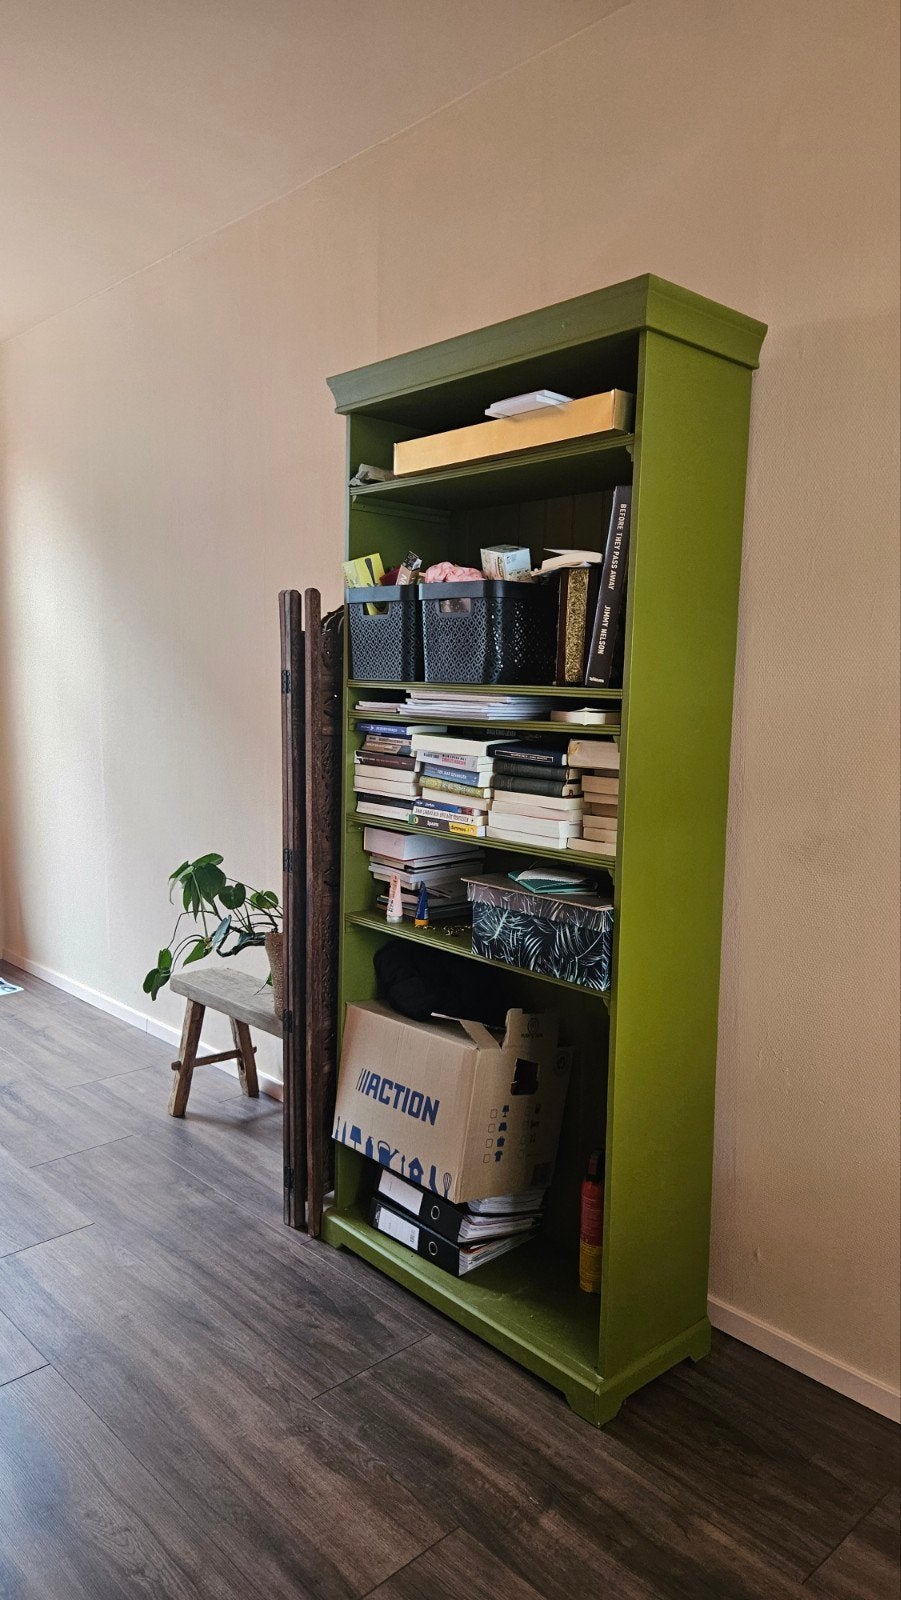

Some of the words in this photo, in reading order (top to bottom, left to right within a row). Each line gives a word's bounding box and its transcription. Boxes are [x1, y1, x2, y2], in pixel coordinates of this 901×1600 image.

[616, 503, 627, 530] BEFORE
[614, 532, 623, 550] THEY
[611, 551, 620, 569] PASS
[608, 570, 617, 590] AWAY
[602, 605, 611, 627] JIMMY
[597, 628, 607, 655] NELSON
[365, 1072, 440, 1126] ACTION
